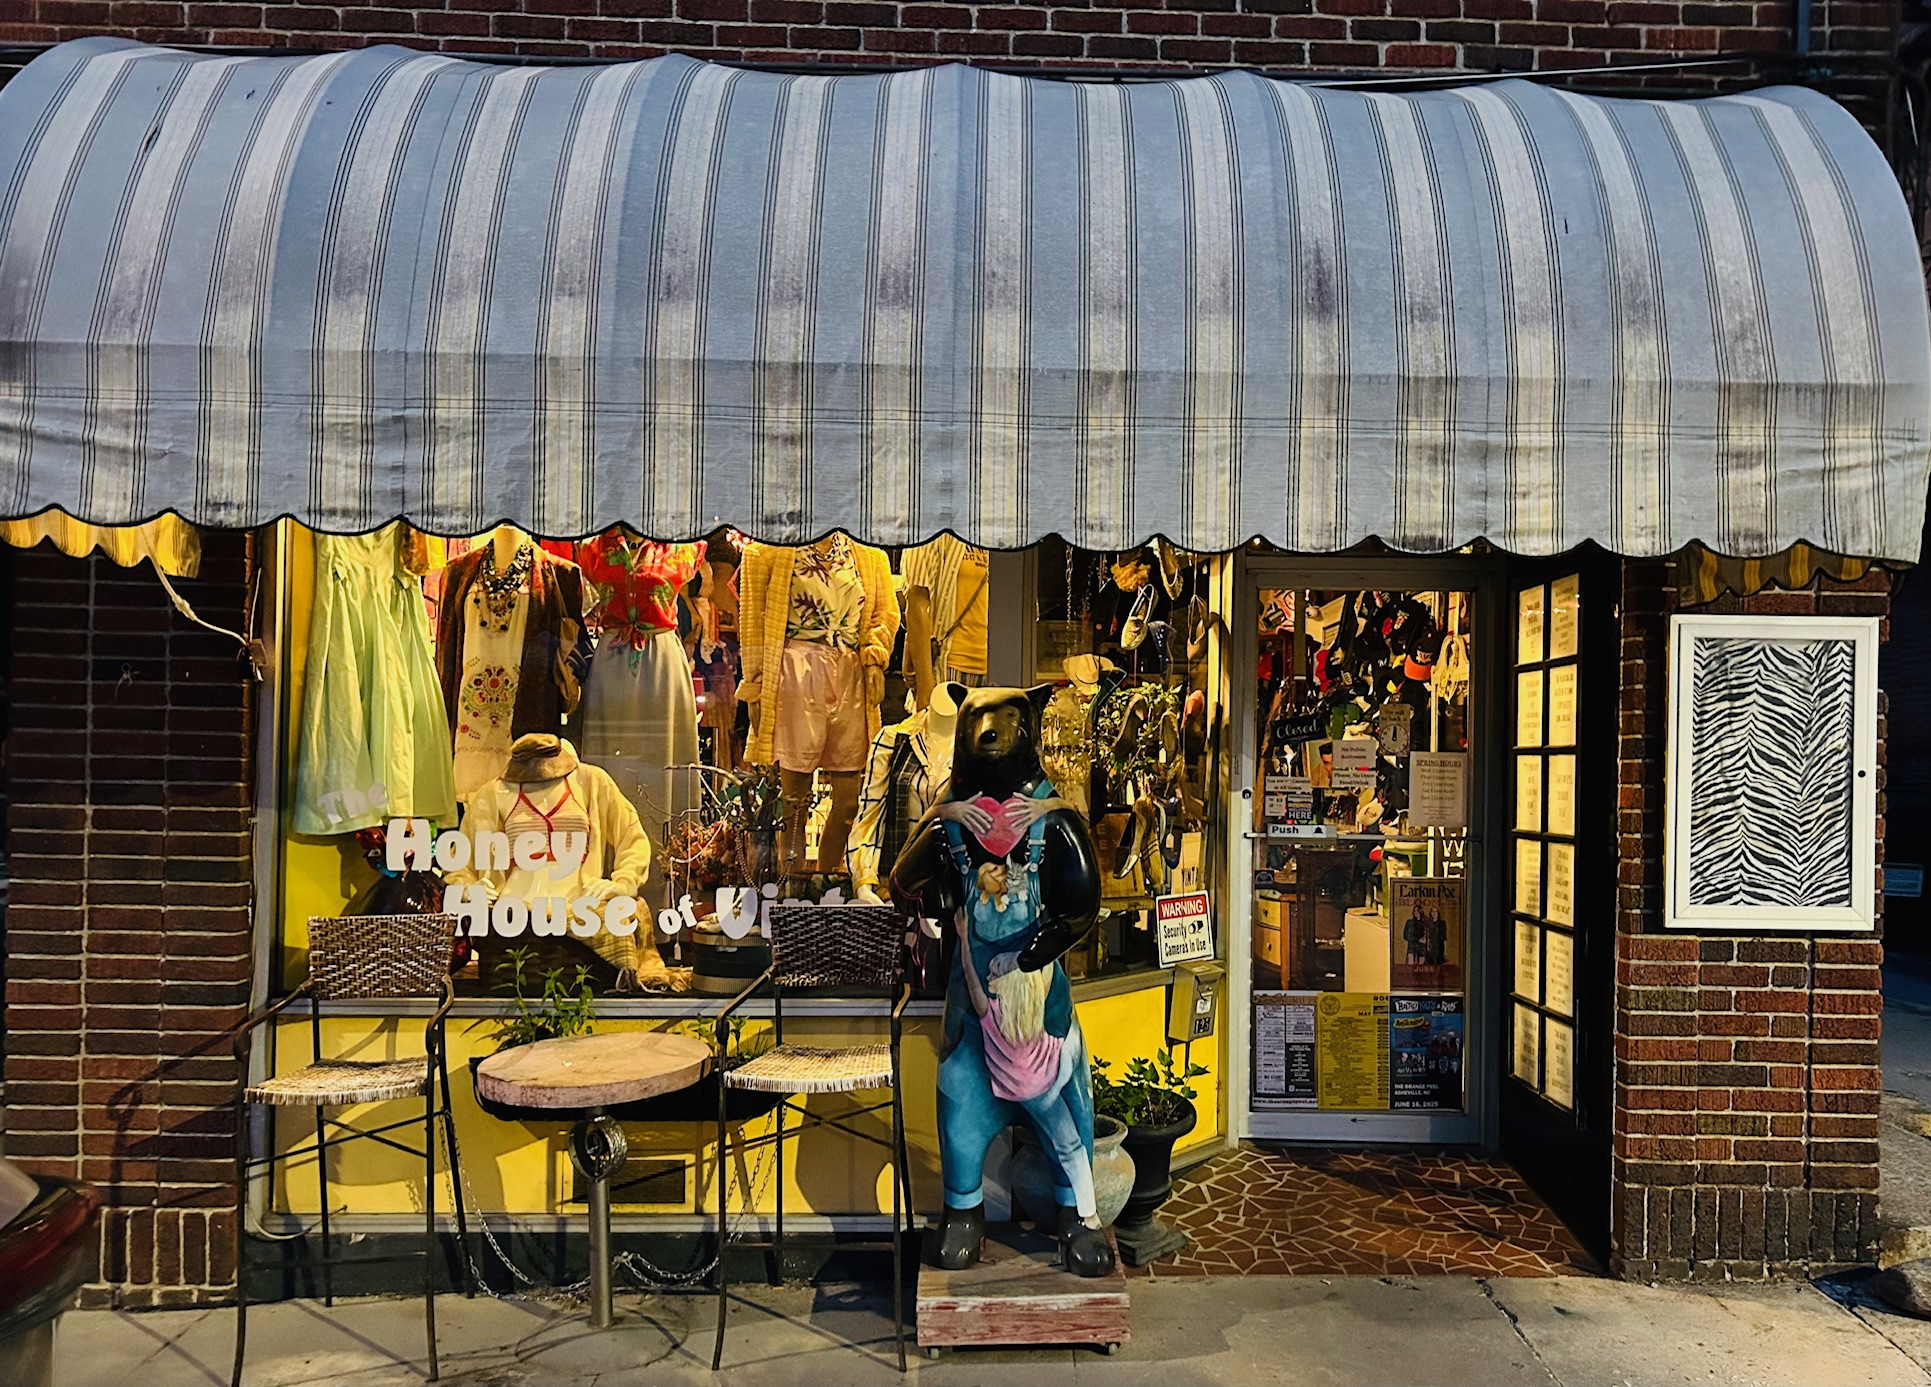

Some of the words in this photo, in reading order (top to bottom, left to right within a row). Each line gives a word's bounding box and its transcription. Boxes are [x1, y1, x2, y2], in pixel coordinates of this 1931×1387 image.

[1276, 719, 1319, 739] Closed
[316, 783, 389, 825] The
[1289, 811, 1312, 819] HERE
[1271, 825, 1299, 834] Push
[385, 818, 588, 882] Honey
[1399, 884, 1435, 898] Larkin
[1437, 884, 1456, 898] Poe
[443, 884, 639, 938] House
[657, 894, 700, 936] of
[1161, 899, 1204, 918] WARNING
[1163, 923, 1187, 940] Security
[1164, 942, 1188, 957] Cameras
[1189, 940, 1195, 952] In
[1196, 938, 1206, 951] Use
